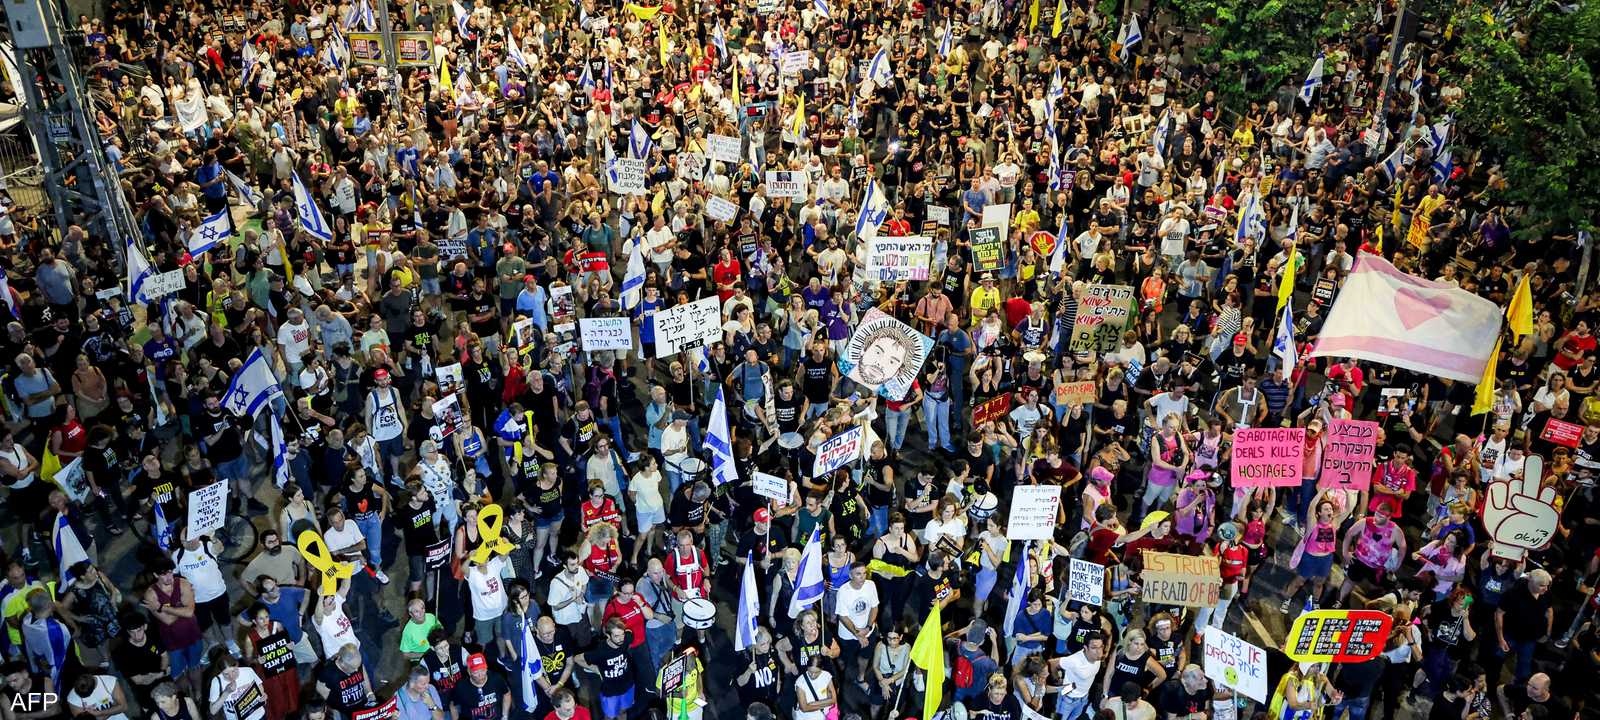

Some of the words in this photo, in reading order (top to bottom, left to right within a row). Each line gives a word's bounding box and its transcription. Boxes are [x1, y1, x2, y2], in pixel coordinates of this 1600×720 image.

[1237, 429, 1304, 444] SABOTAGING
[1333, 424, 1373, 438] מבצע
[1235, 446, 1265, 459] DEALS
[1270, 445, 1300, 459] KILLS
[1331, 442, 1373, 457] הפקרת
[1239, 463, 1296, 478] HOSTAGES
[1072, 560, 1088, 571] HOW
[1088, 563, 1104, 576] MANY
[1145, 556, 1165, 573] IS
[1174, 557, 1219, 577] TRUMP
[1072, 571, 1088, 583] MORE
[1090, 575, 1102, 586] FOR
[1144, 580, 1188, 602] AFRAID
[1191, 581, 1204, 603] OF
[262, 643, 276, 654] אדם
[278, 638, 287, 648] בני
[604, 668, 624, 678] Life
[754, 666, 775, 688] NO.
